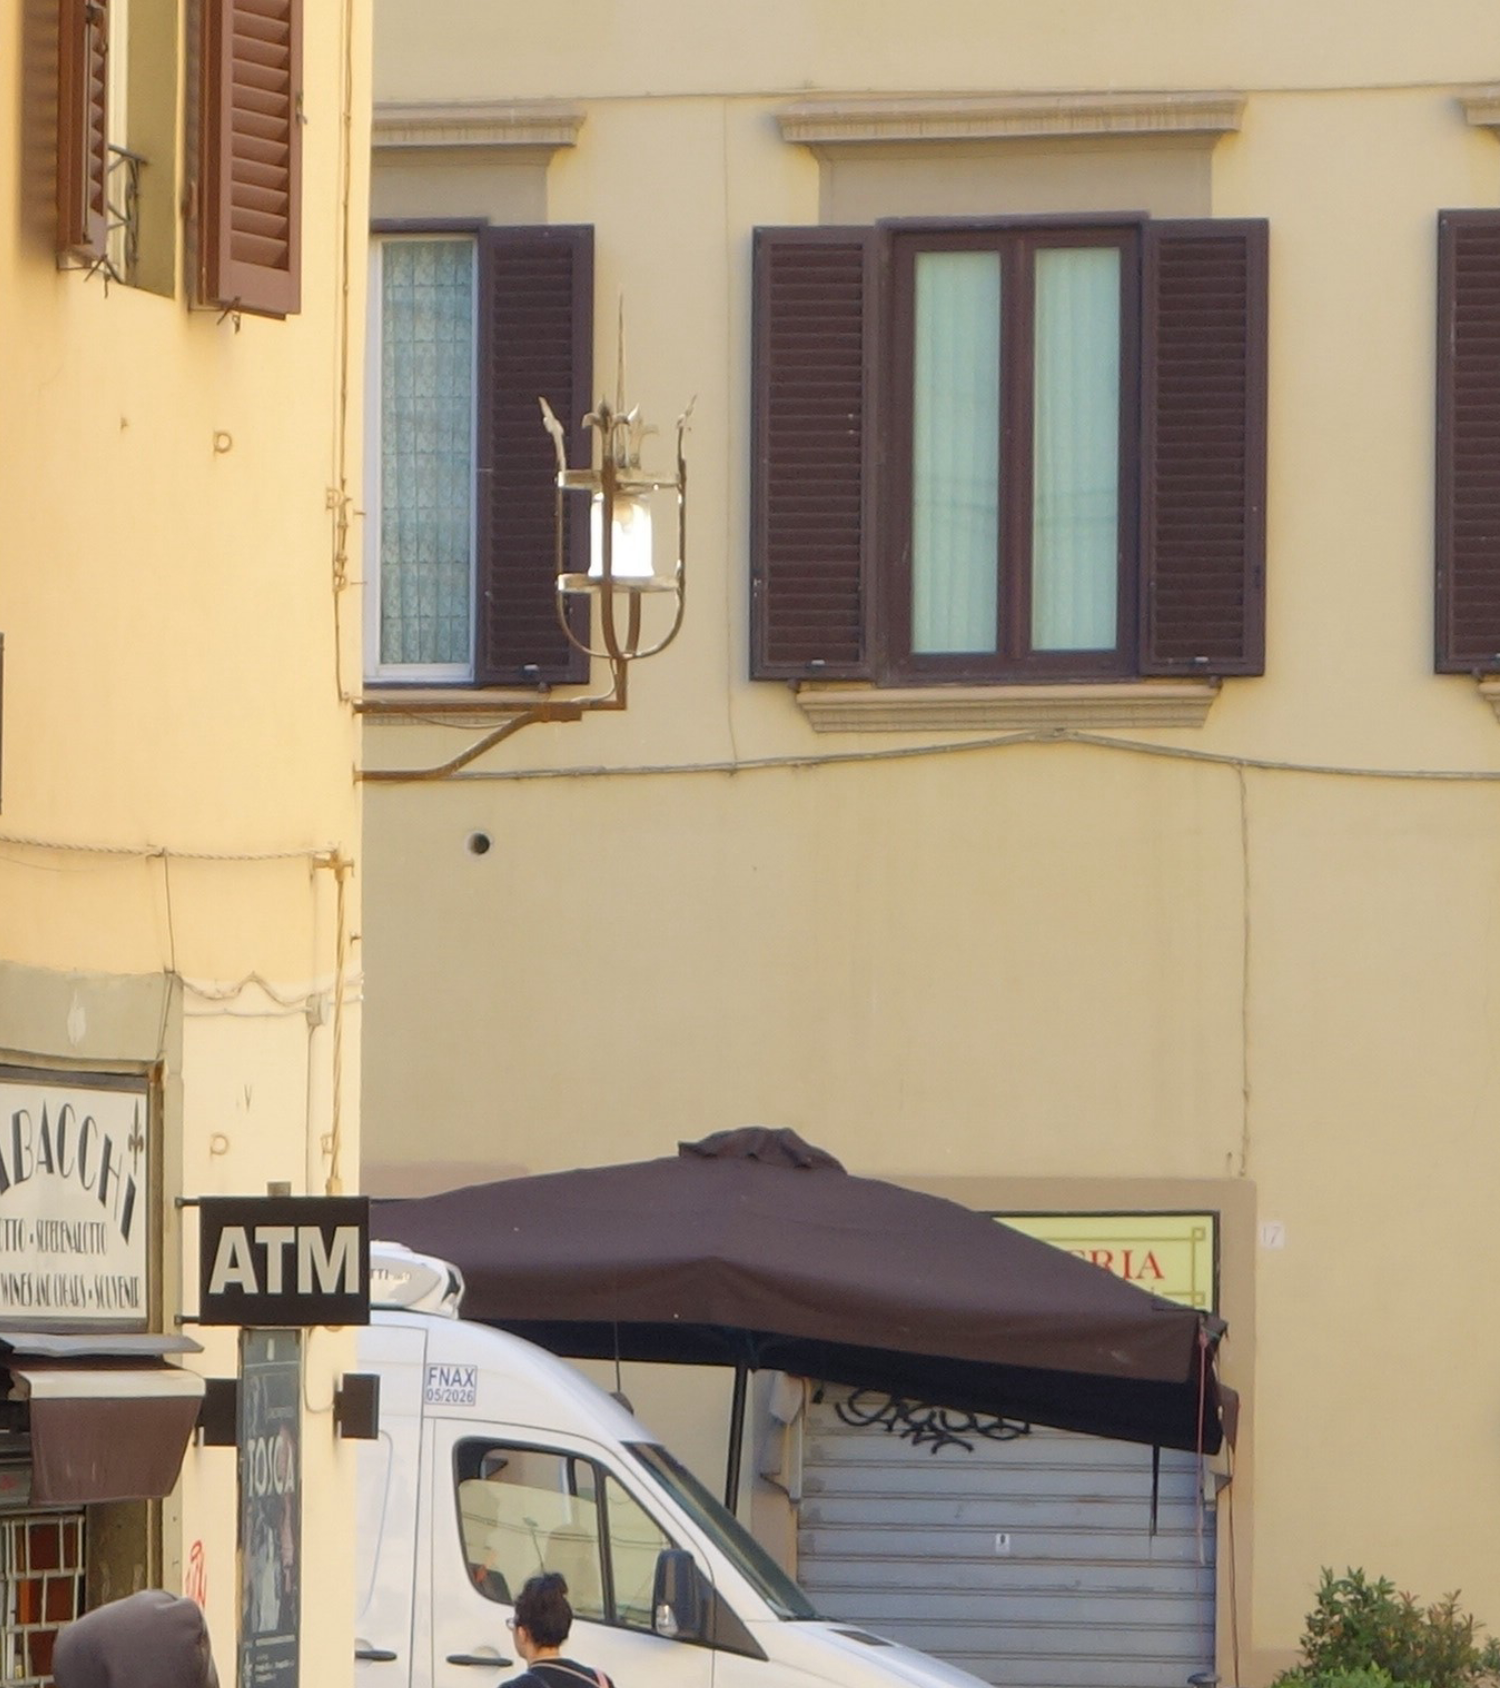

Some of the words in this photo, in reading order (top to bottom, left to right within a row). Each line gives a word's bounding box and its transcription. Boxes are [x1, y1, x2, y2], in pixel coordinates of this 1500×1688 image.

[208, 1226, 361, 1296] ATM
[0, 1272, 33, 1308] WINES
[35, 1273, 52, 1308] AND
[54, 1273, 87, 1309] CIGARS
[426, 1387, 474, 1403] 05/2026
[427, 1366, 475, 1387] FNAX
[247, 1436, 296, 1497] TOSCA
